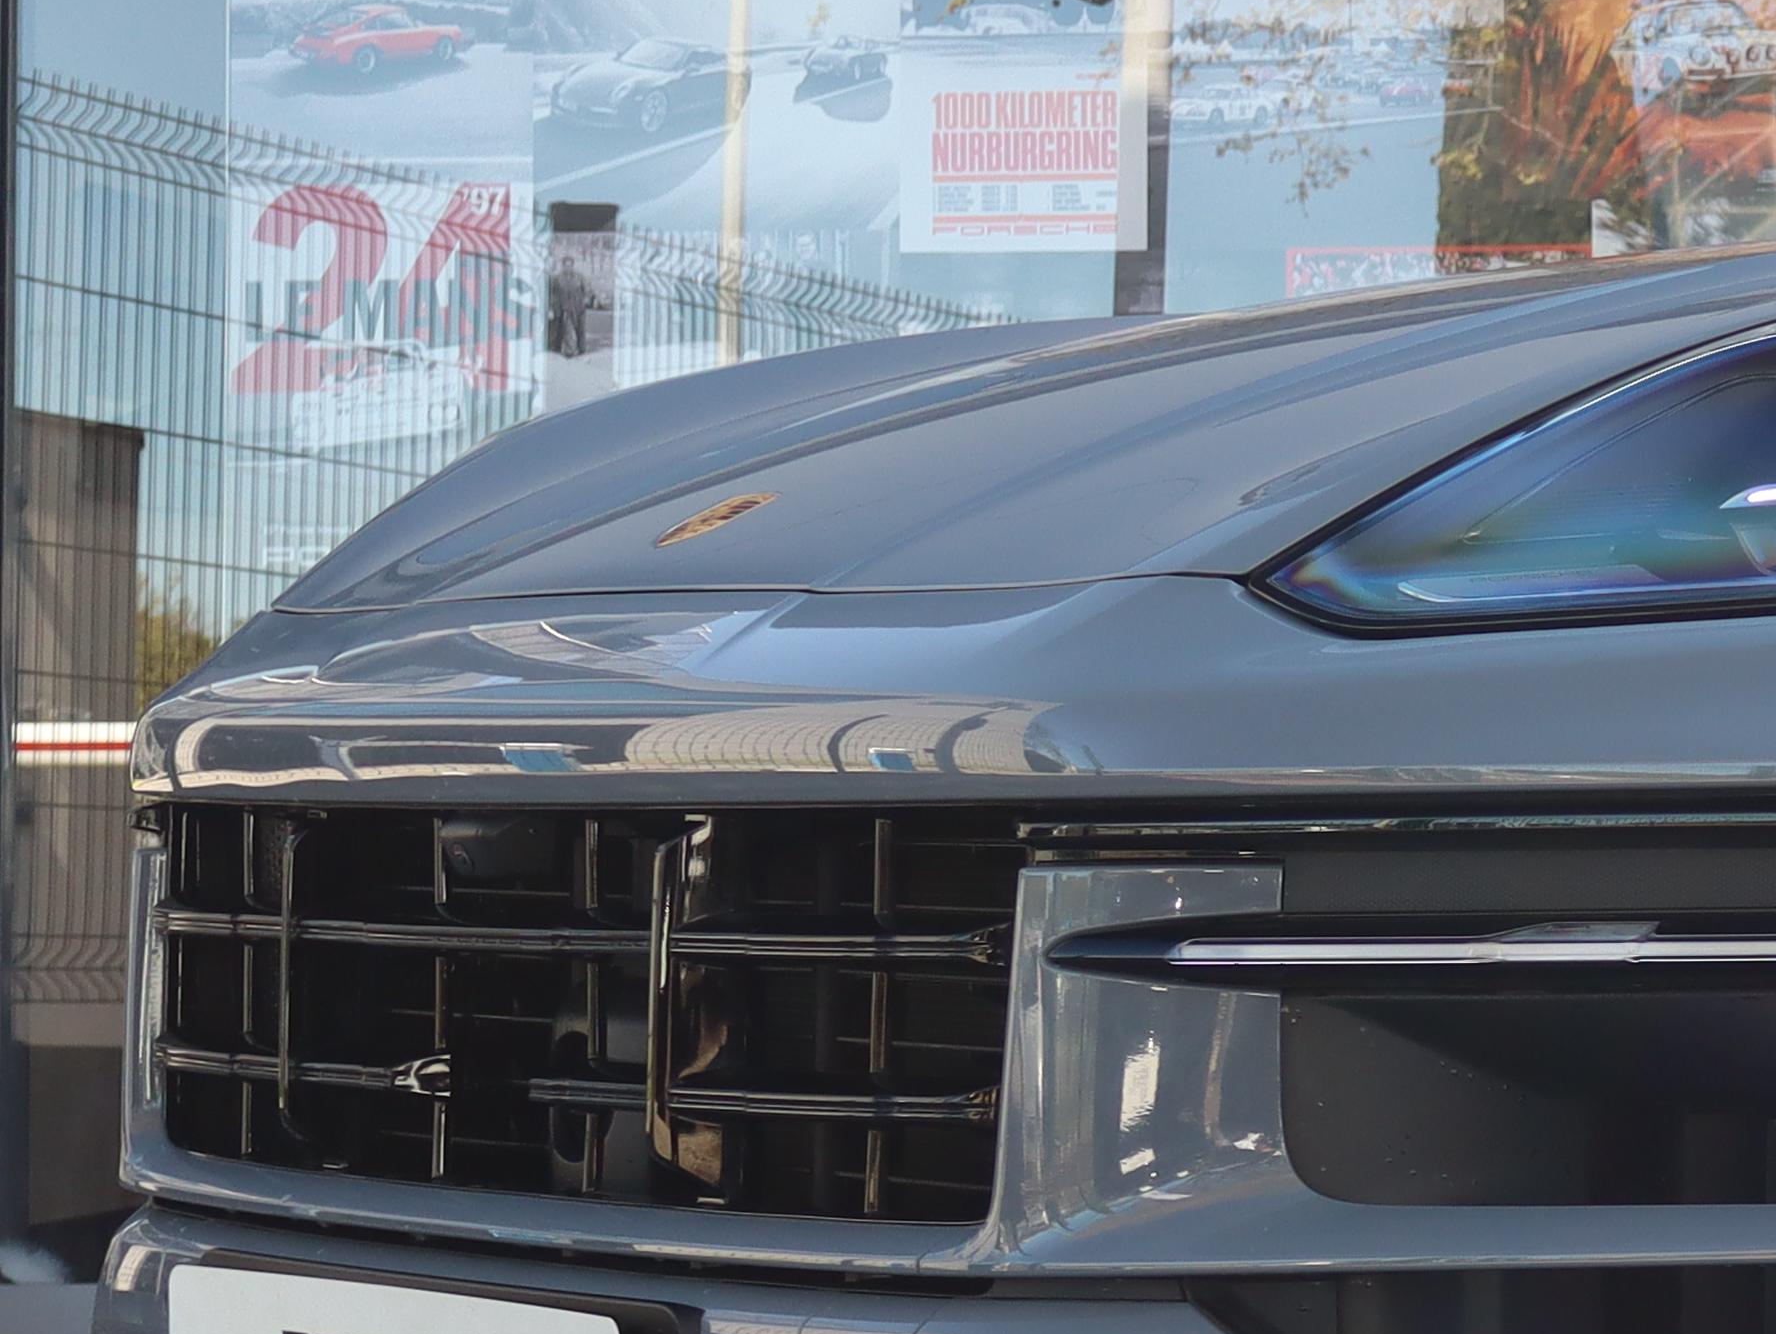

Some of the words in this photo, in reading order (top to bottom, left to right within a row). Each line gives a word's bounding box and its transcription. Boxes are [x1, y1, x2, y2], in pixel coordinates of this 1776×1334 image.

[931, 91, 992, 130] 1000
[995, 89, 1118, 129] KILOMETER
[931, 223, 1119, 237] PORSCHE
[245, 280, 323, 343] LE
[341, 278, 537, 349] MANS
